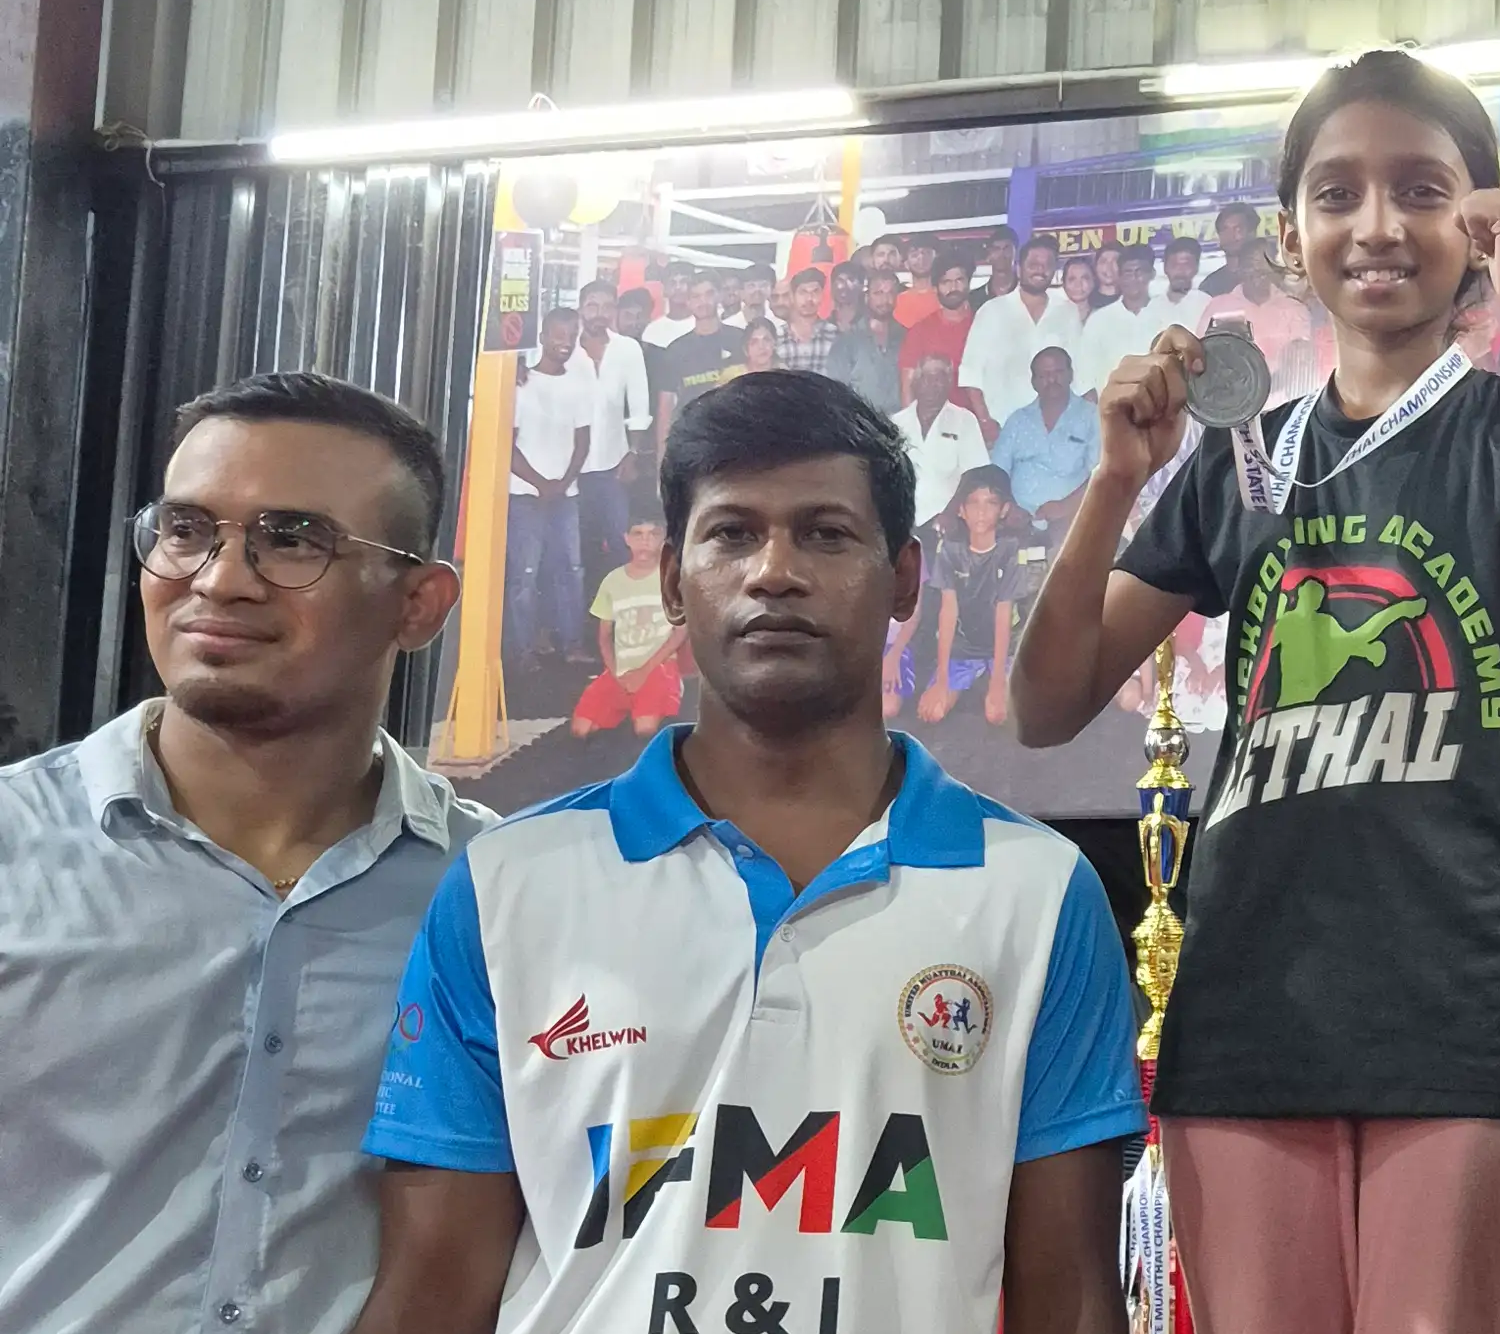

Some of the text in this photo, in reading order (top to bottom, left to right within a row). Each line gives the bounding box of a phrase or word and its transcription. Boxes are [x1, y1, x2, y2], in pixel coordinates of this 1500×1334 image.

[1380, 353, 1465, 435] CHAMPIONSHIP
[1205, 690, 1464, 832] LETHAL
[566, 1026, 647, 1055] KHELWIN
[575, 1103, 949, 1250] IFMA
[1153, 1250, 1165, 1320] MUAYTHAI
